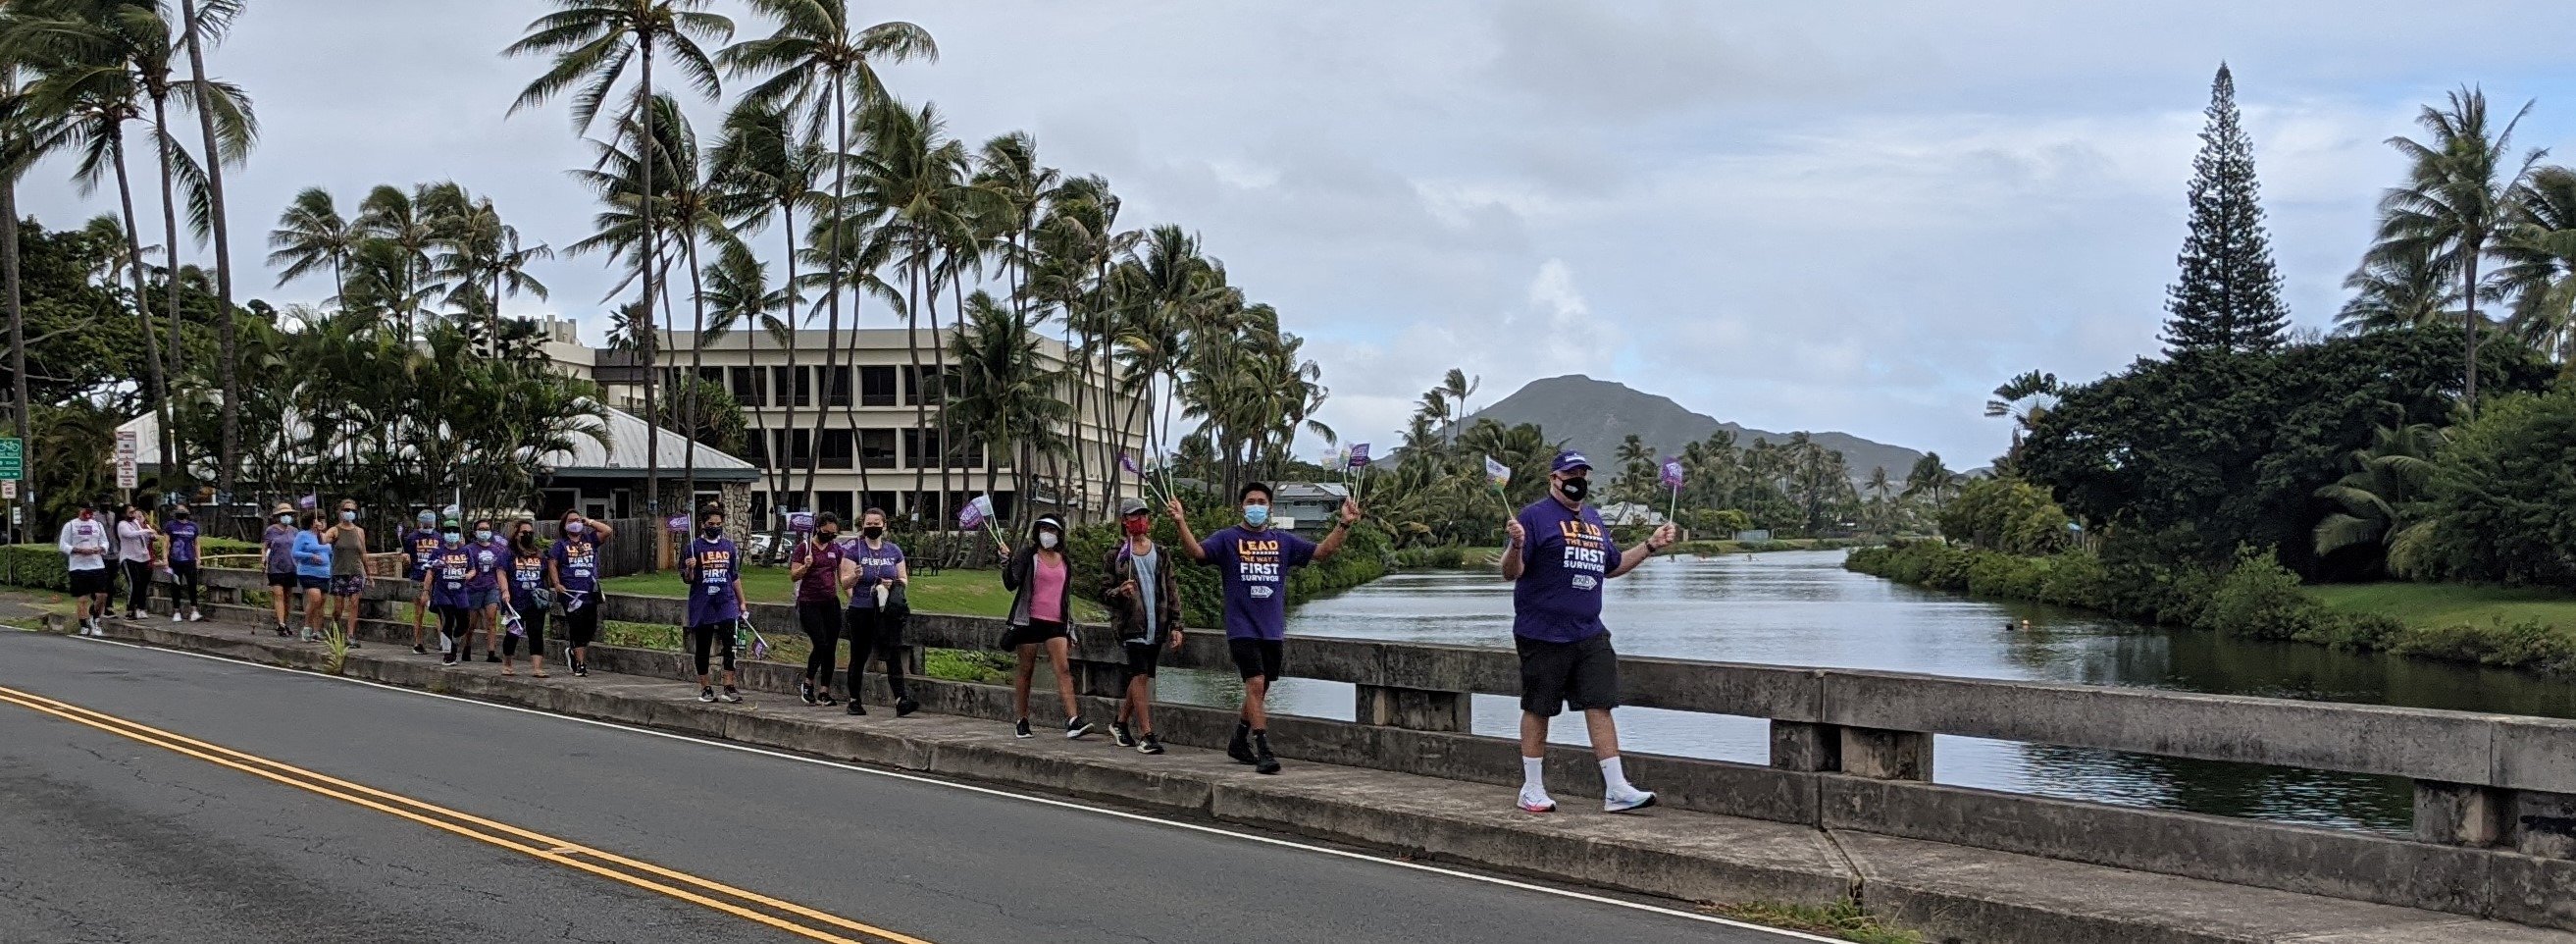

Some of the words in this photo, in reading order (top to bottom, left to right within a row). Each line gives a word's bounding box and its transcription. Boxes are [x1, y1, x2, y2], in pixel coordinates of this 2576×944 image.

[1238, 538, 1279, 555] LEAD
[700, 551, 730, 564] LEAD
[1564, 547, 1606, 563] FIRST
[1240, 562, 1279, 575] FIRST
[1563, 560, 1605, 574] SURVIVOR
